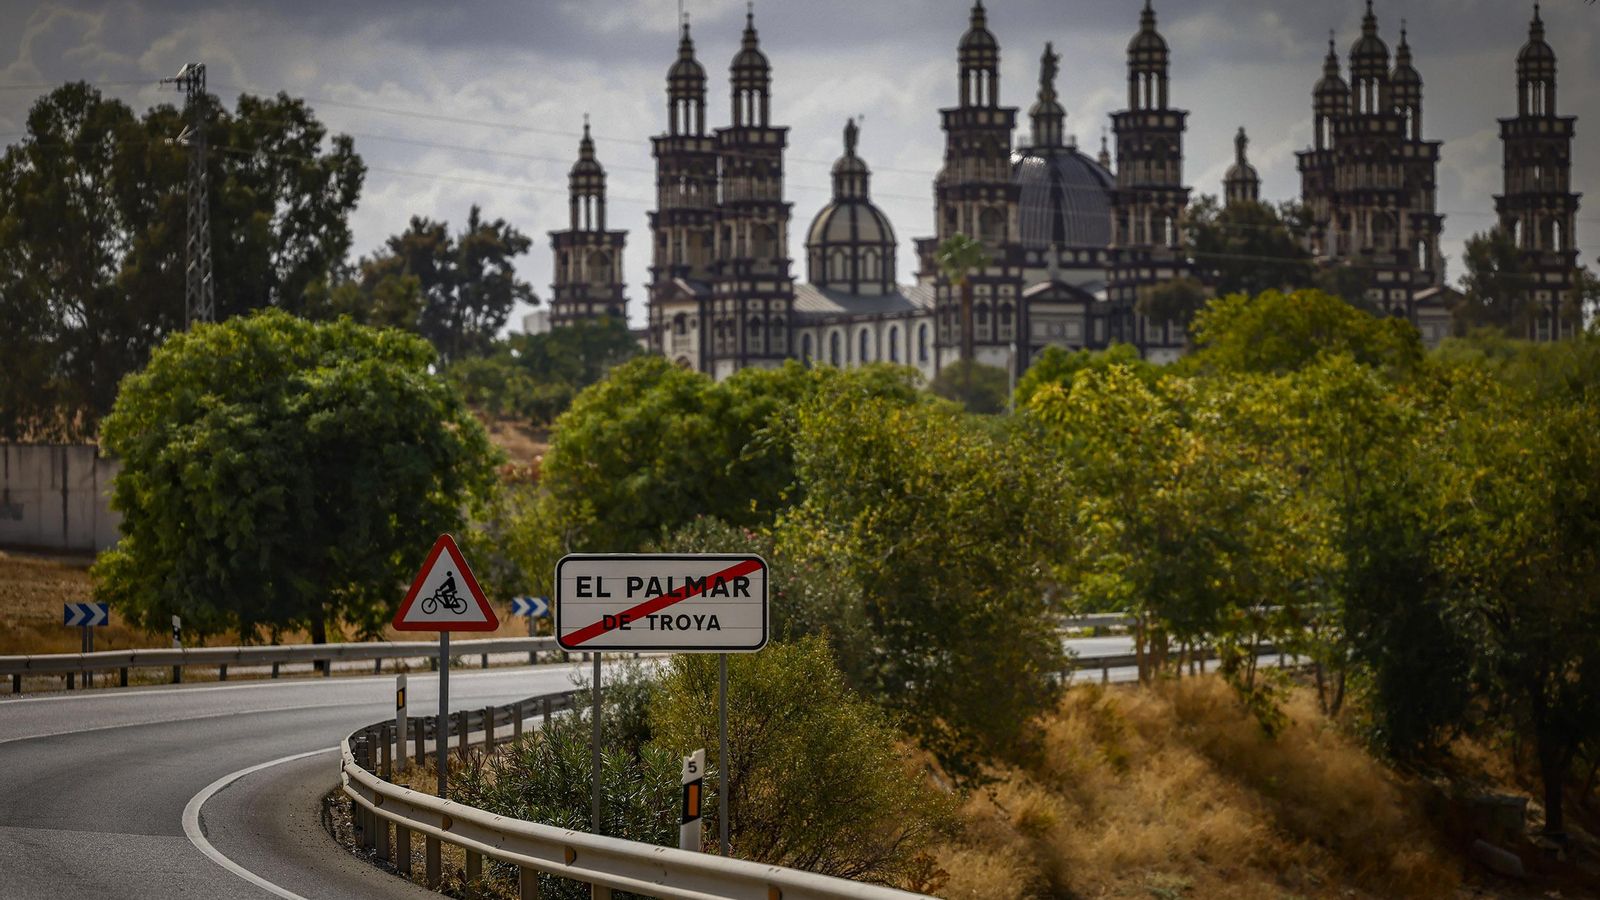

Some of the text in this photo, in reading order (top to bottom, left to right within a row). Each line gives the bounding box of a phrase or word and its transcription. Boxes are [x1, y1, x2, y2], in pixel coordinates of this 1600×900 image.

[576, 576, 751, 598] EL PALMAR
[602, 614, 721, 631] DE TROYA
[688, 761, 698, 774] 5
